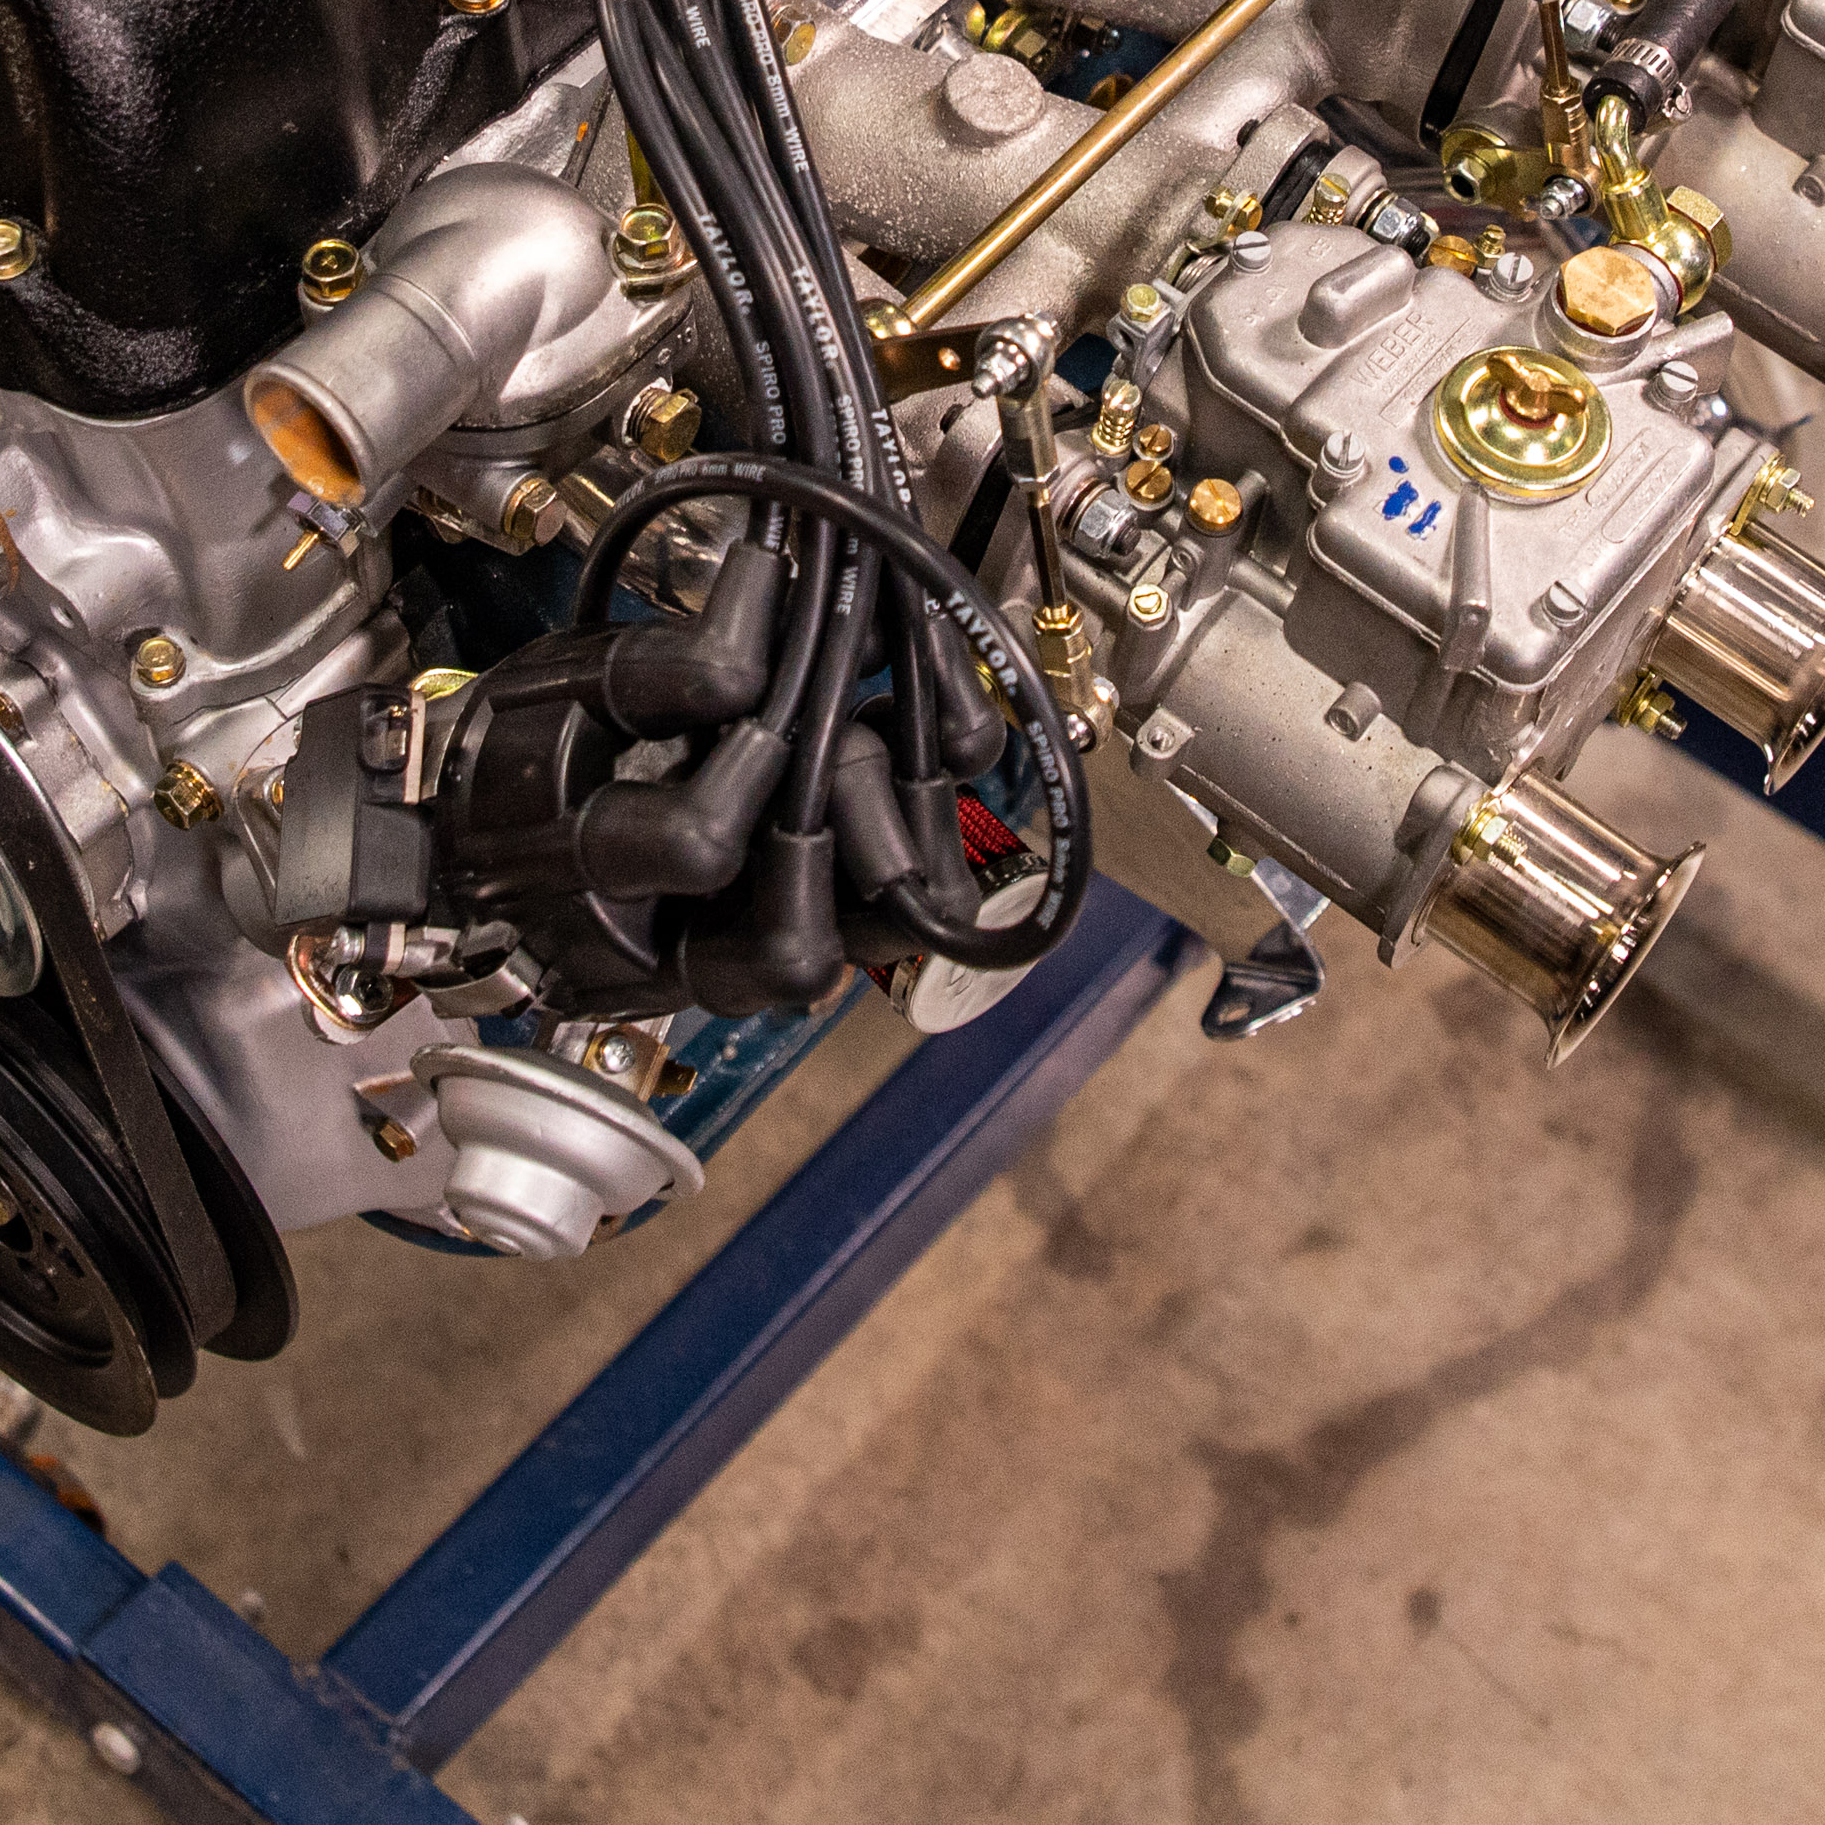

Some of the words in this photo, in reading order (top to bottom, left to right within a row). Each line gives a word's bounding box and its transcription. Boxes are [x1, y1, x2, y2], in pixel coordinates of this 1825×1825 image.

[685, 5, 712, 50] WIRE
[750, 25, 774, 67] PRO
[766, 73, 790, 119] 8mm
[783, 126, 810, 174] WIRE
[1349, 307, 1435, 390] WEBER
[755, 340, 781, 400] SPIRO
[769, 405, 786, 445] PRO
[838, 394, 861, 452] SPIRO
[734, 462, 766, 482] WIRE
[837, 566, 858, 616] WIRE
[1028, 720, 1060, 783] SPIRO
[1049, 786, 1069, 830] PRO
